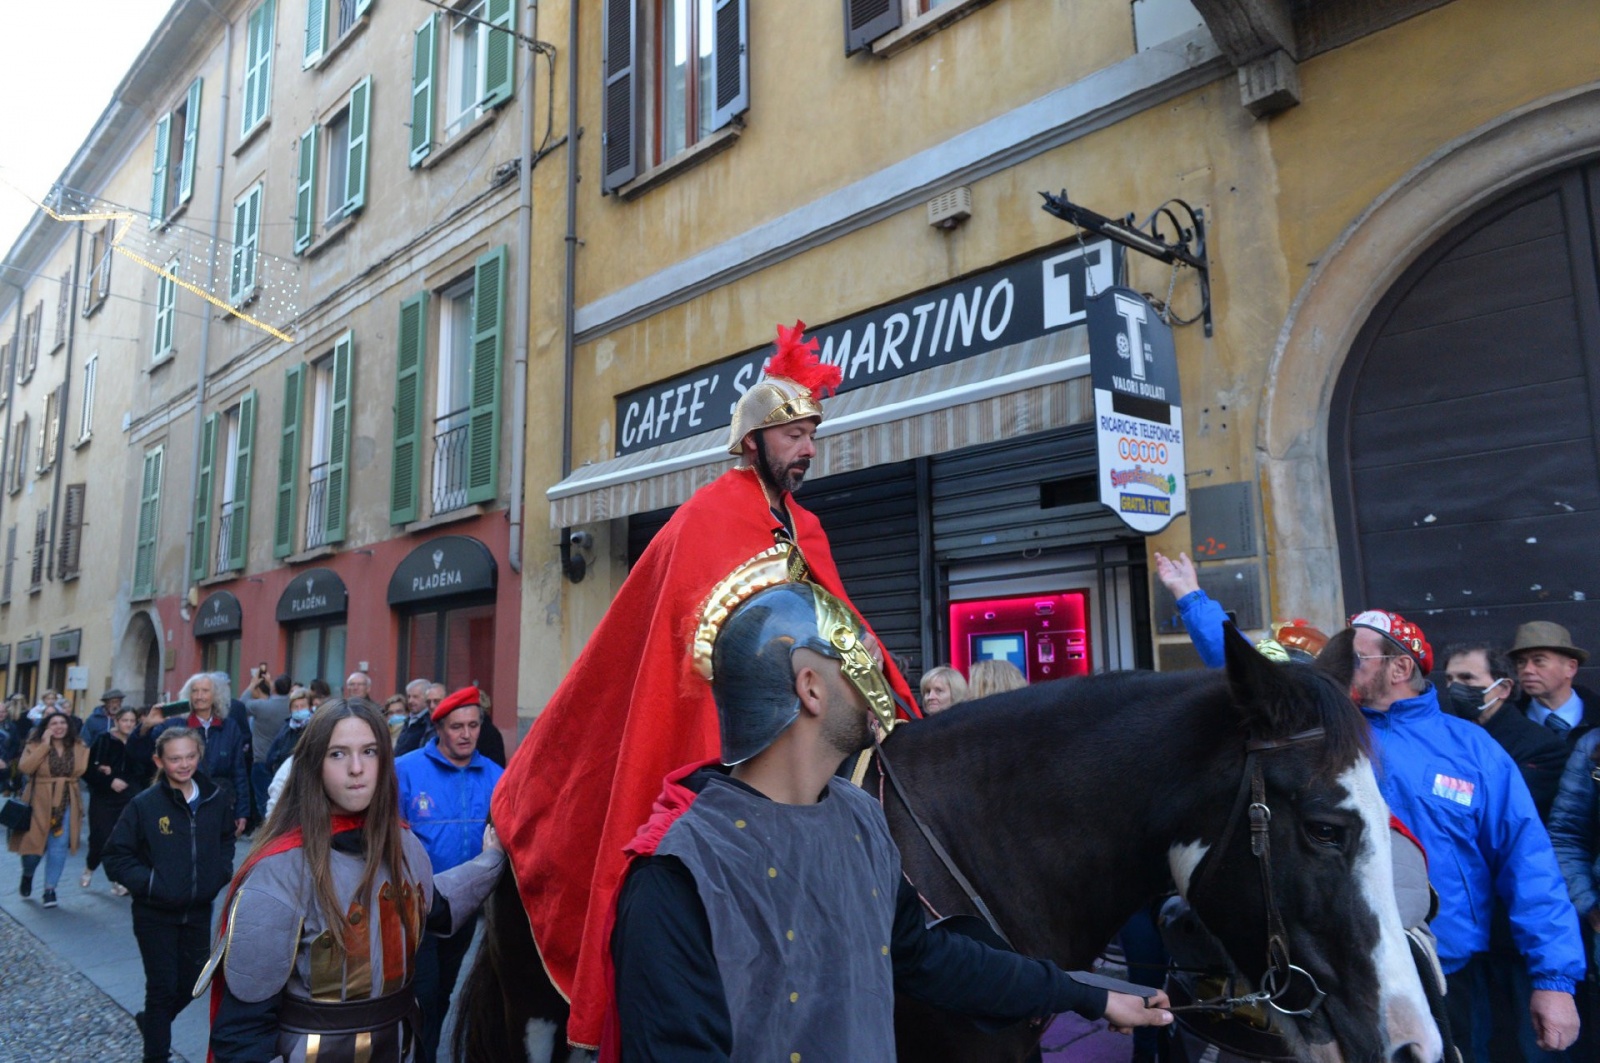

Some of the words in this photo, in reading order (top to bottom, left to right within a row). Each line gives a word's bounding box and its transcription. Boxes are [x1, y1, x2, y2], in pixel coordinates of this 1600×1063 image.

[1114, 293, 1148, 381] T
[622, 374, 720, 448] CAFFE'
[818, 277, 1015, 380] MARTINO
[1112, 375, 1139, 394] VALORI
[1139, 382, 1166, 401] BOLLATI
[1101, 415, 1138, 437] RICARICHE
[1139, 422, 1181, 444] TELEFONICHE
[1121, 496, 1147, 512] GRATTA
[1147, 499, 1152, 513] E
[412, 569, 463, 592] PLADÉNA
[291, 594, 327, 613] PLADÉNA
[981, 639, 1019, 662] T
